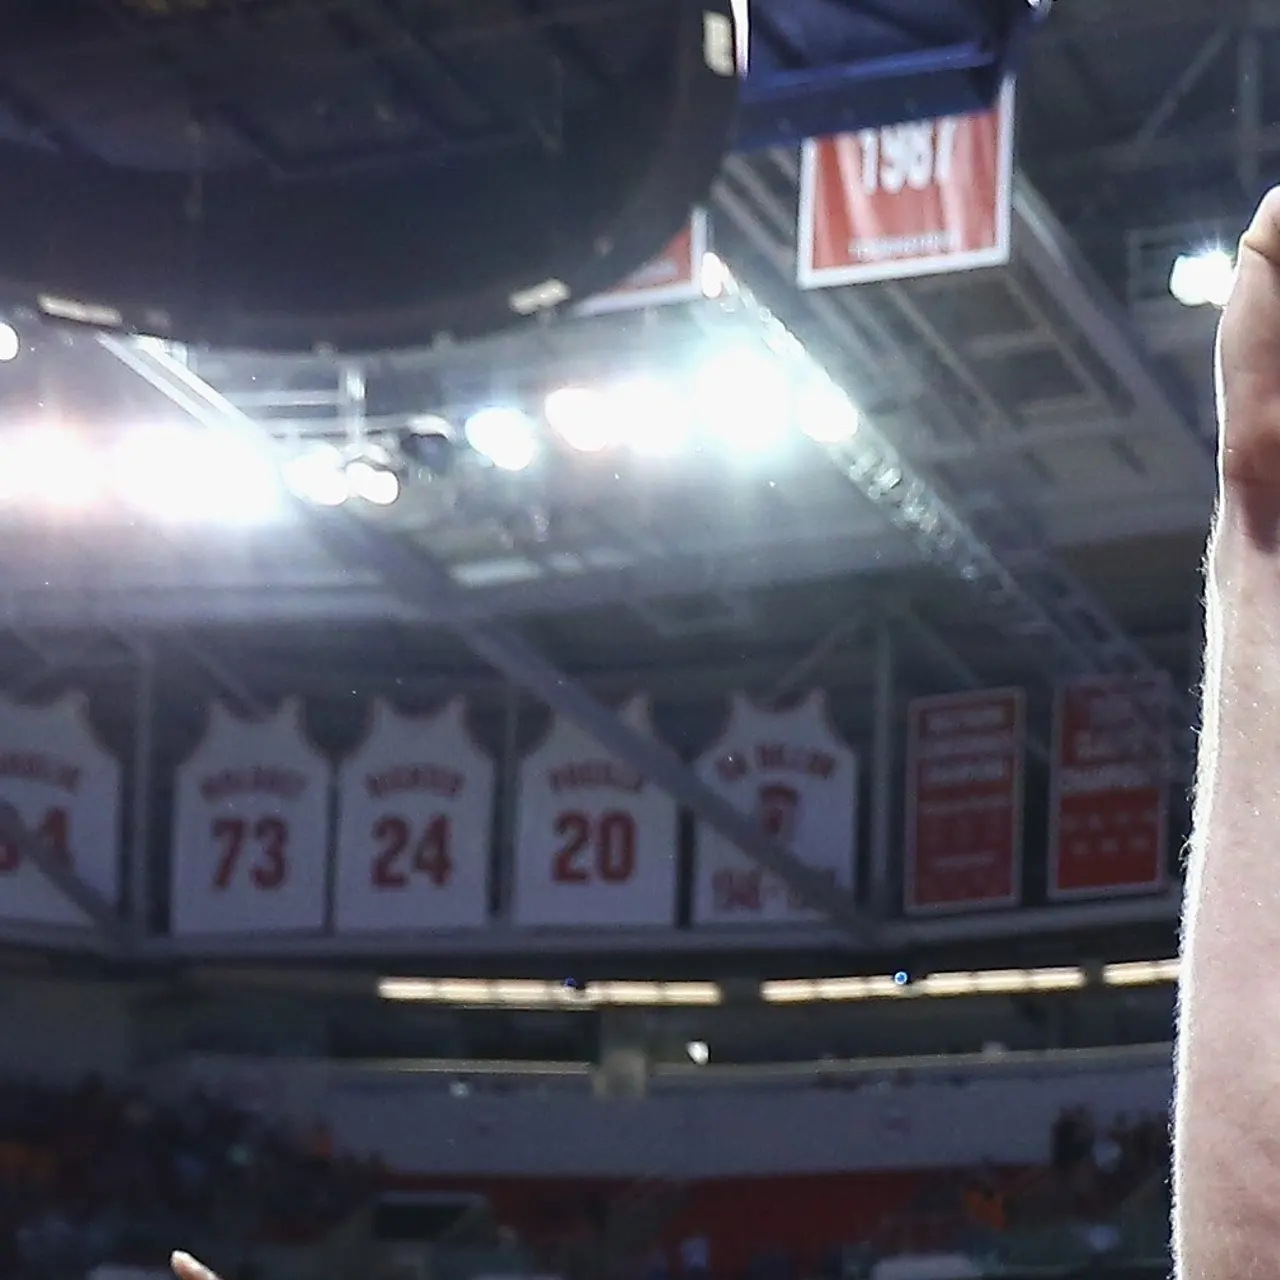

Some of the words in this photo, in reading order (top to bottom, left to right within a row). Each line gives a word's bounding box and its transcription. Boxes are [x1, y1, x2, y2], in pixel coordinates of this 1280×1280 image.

[211, 815, 289, 889] 73
[371, 813, 452, 889] 24
[552, 809, 637, 884] 20
